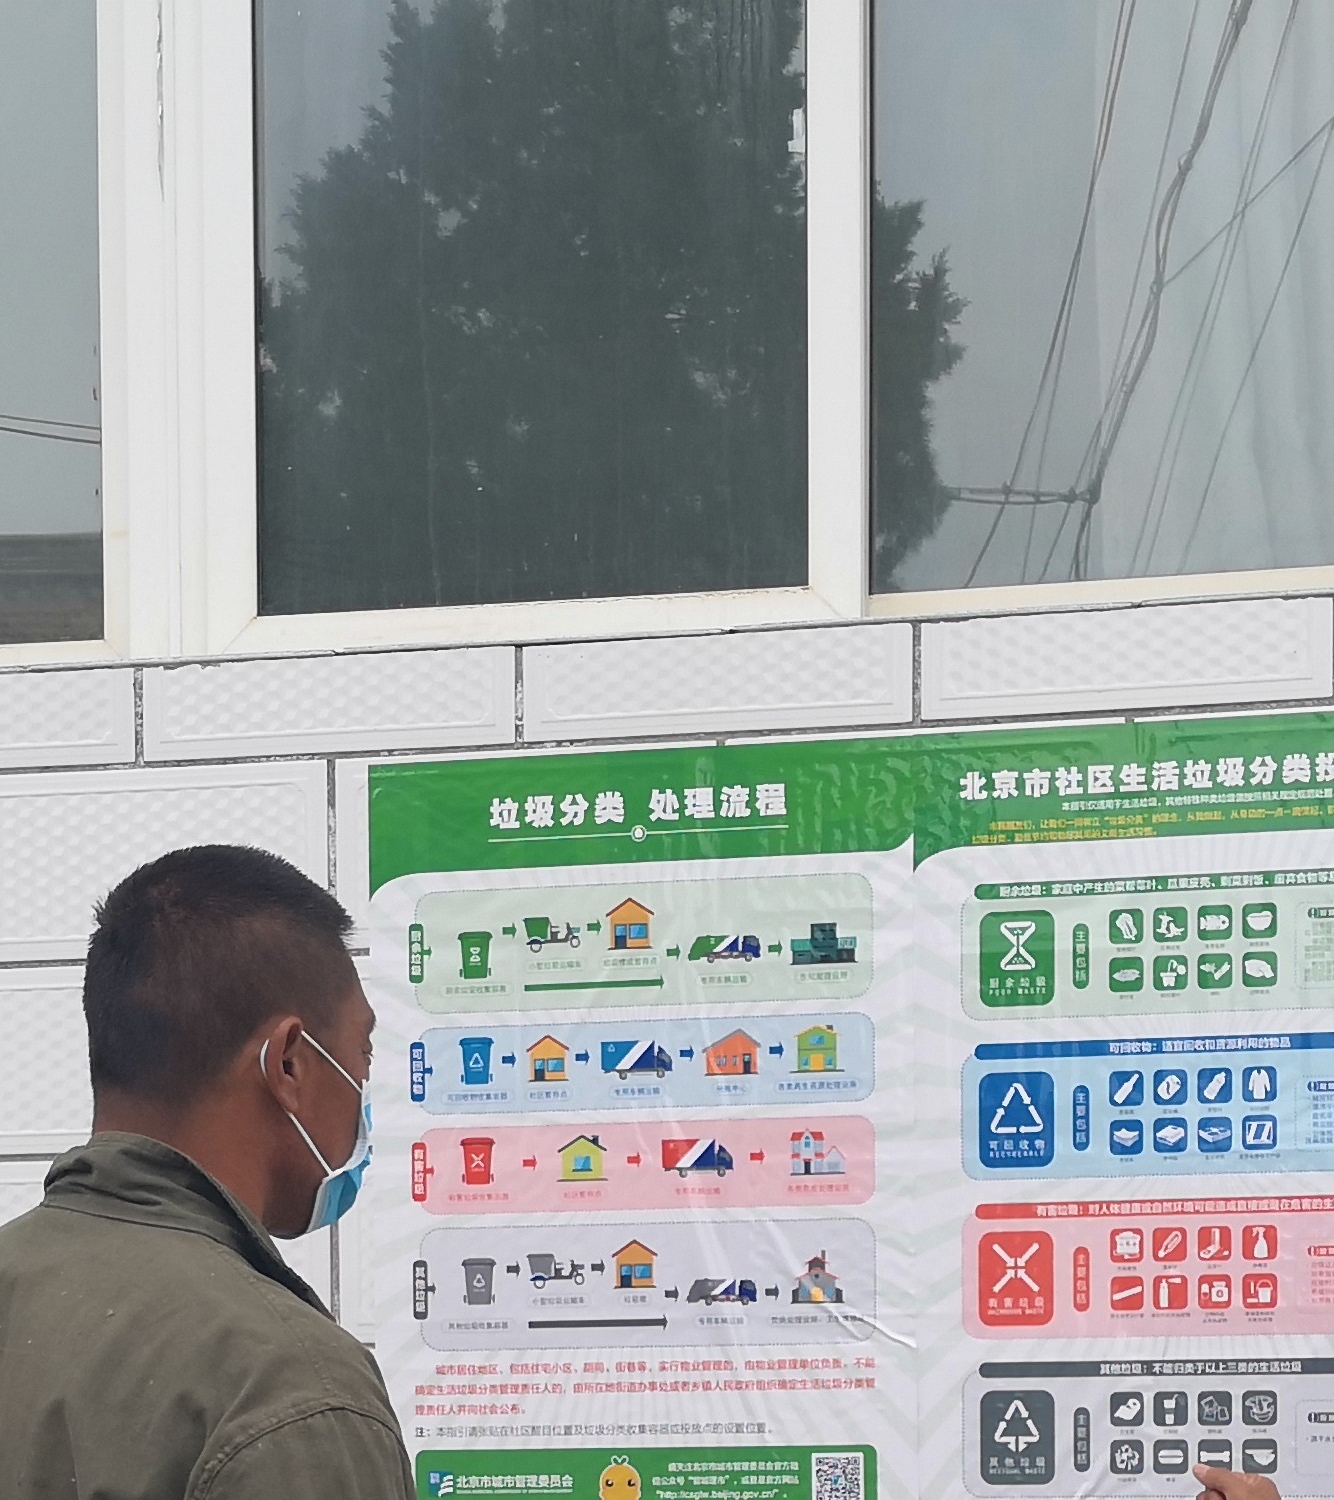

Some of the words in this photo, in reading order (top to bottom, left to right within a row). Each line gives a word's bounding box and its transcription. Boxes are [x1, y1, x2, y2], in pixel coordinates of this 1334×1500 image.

[490, 792, 625, 829] 垃圾分类
[648, 783, 788, 822] 处理流程
[1075, 931, 1086, 982] 主要包括
[1075, 1092, 1087, 1143] 主要包括
[456, 1474, 573, 1488] 北京市城市管理委员会
